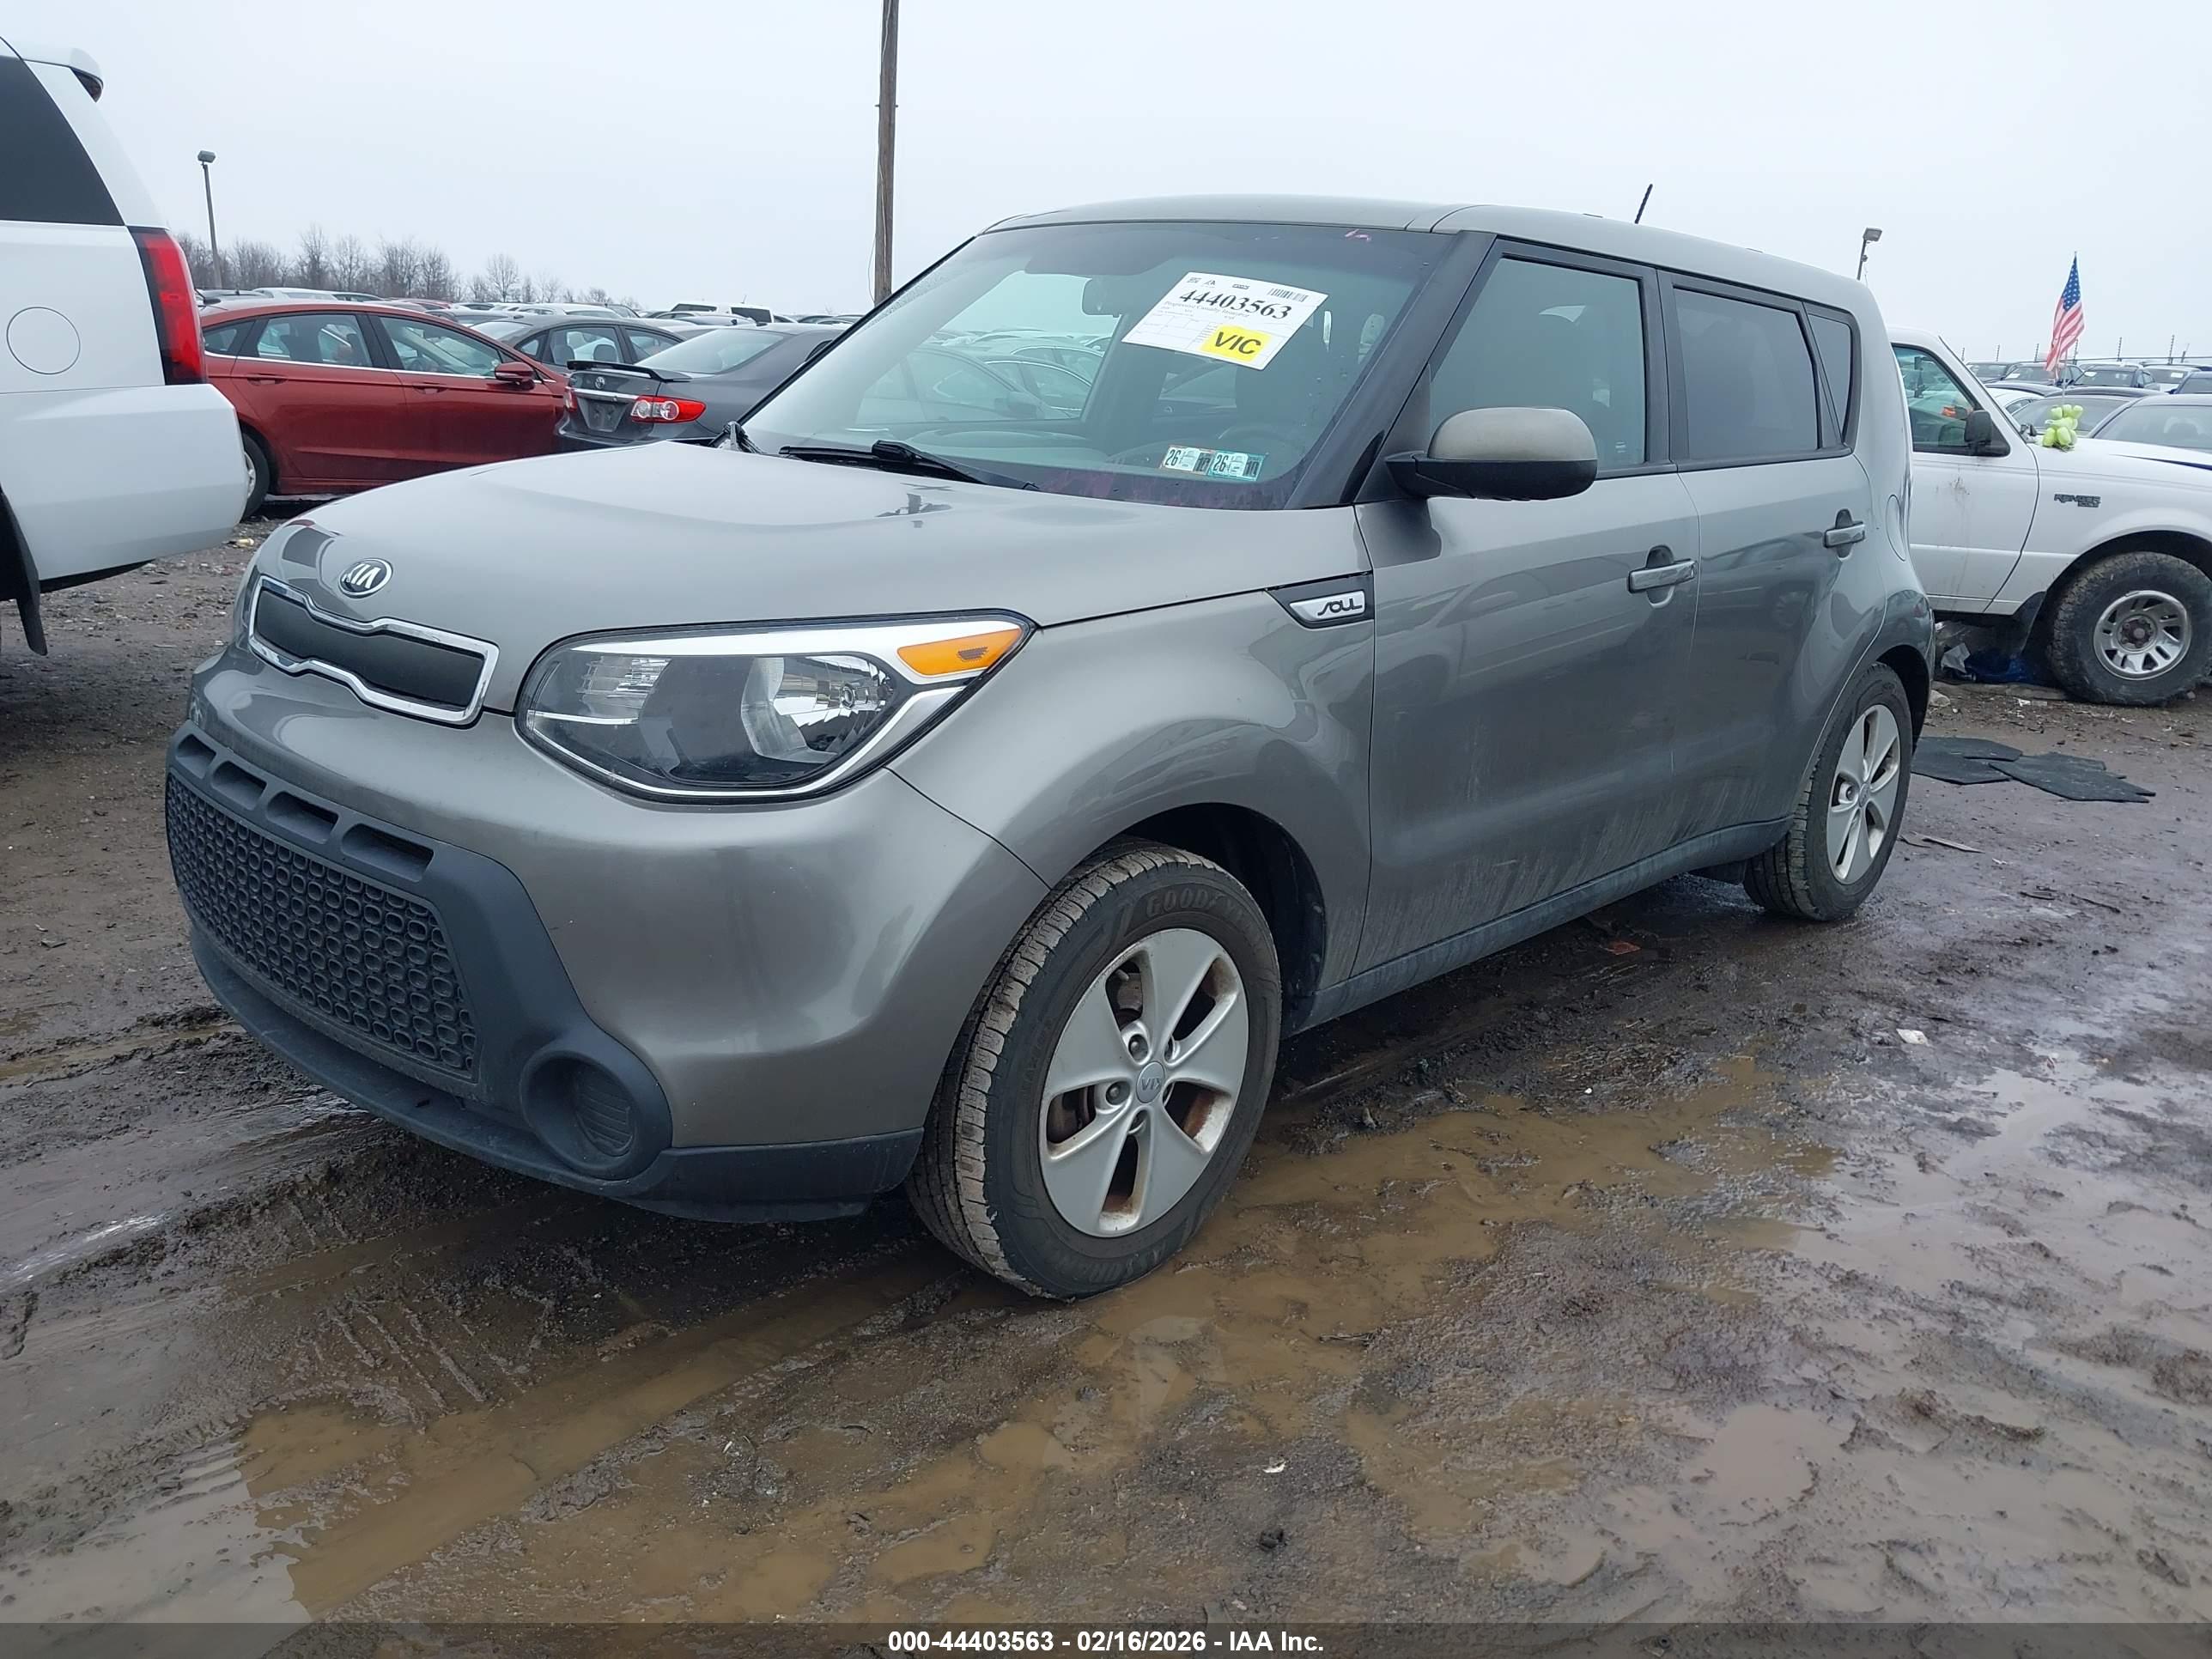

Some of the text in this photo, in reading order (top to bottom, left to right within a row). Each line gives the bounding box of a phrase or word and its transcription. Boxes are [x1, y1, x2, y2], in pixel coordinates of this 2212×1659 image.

[1180, 289, 1292, 320] 44403563
[1213, 331, 1261, 355] VIC
[1165, 448, 1182, 467] 26
[1213, 454, 1229, 472] 26
[1316, 597, 1363, 617] SOUL
